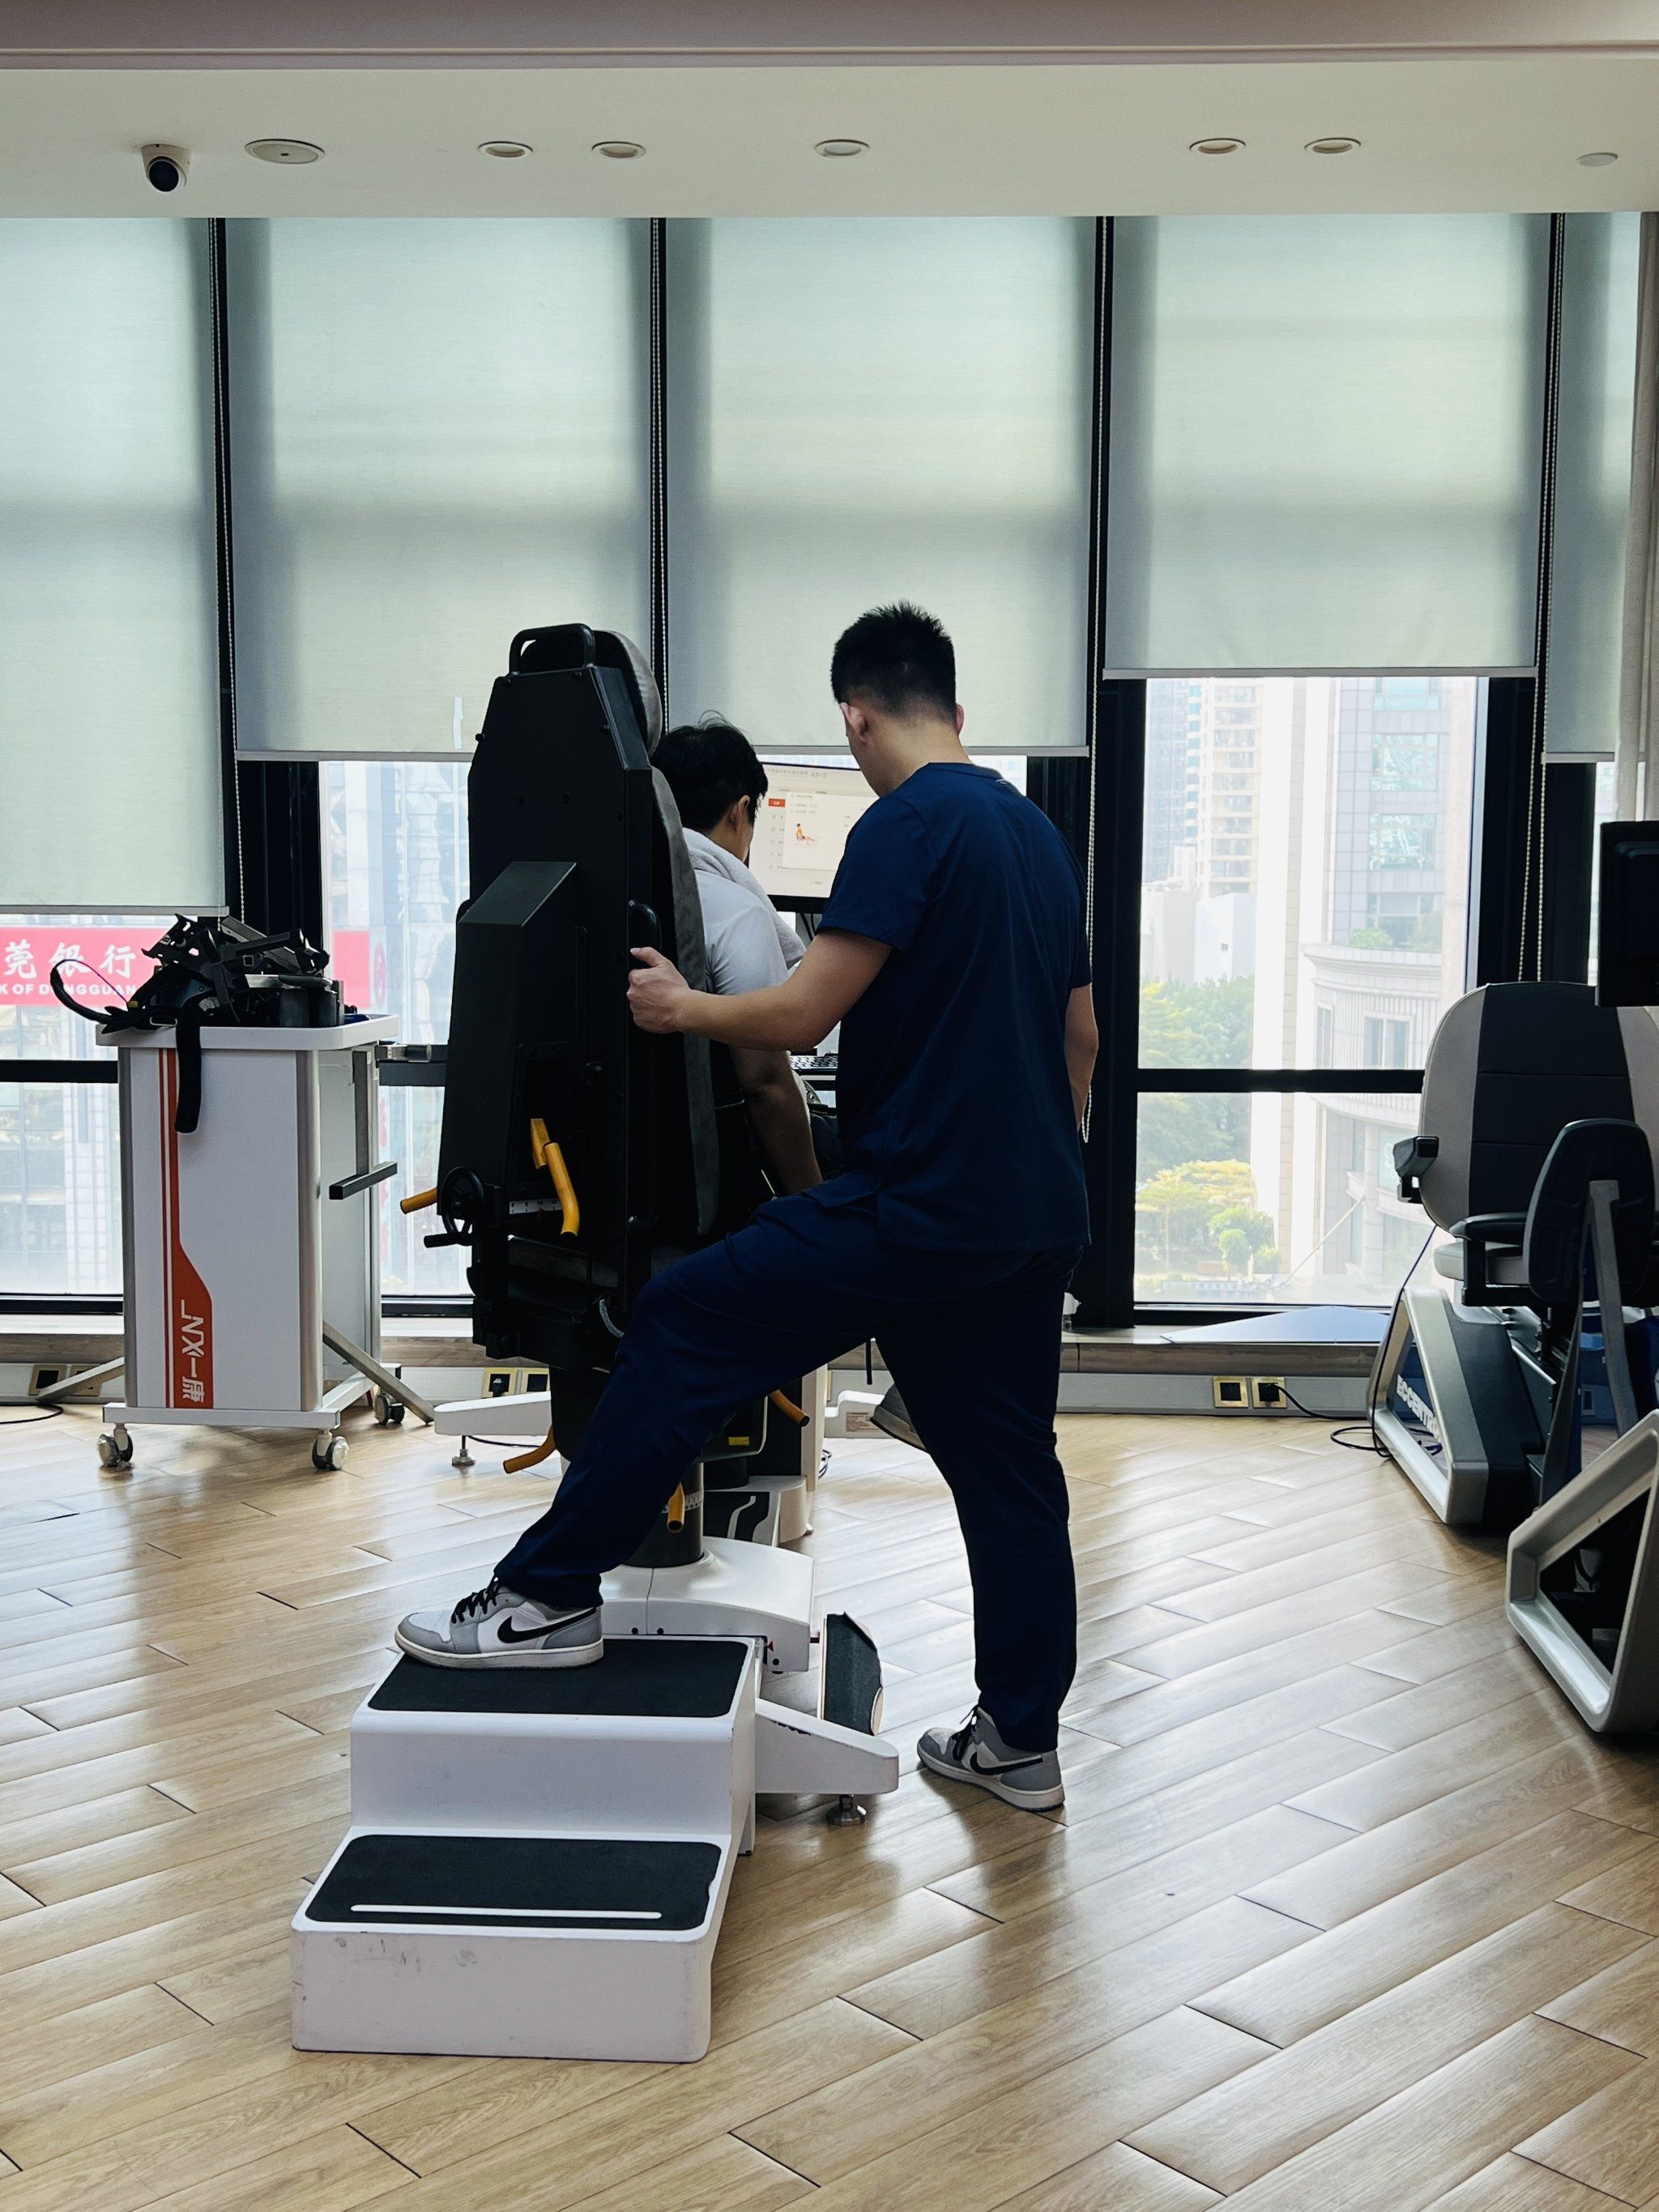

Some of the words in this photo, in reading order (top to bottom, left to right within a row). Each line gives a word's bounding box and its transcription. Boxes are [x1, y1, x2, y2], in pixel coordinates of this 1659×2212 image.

[4, 939, 136, 978] 莞银行
[12, 983, 34, 995] OF
[39, 983, 137, 995] DNGGUAN
